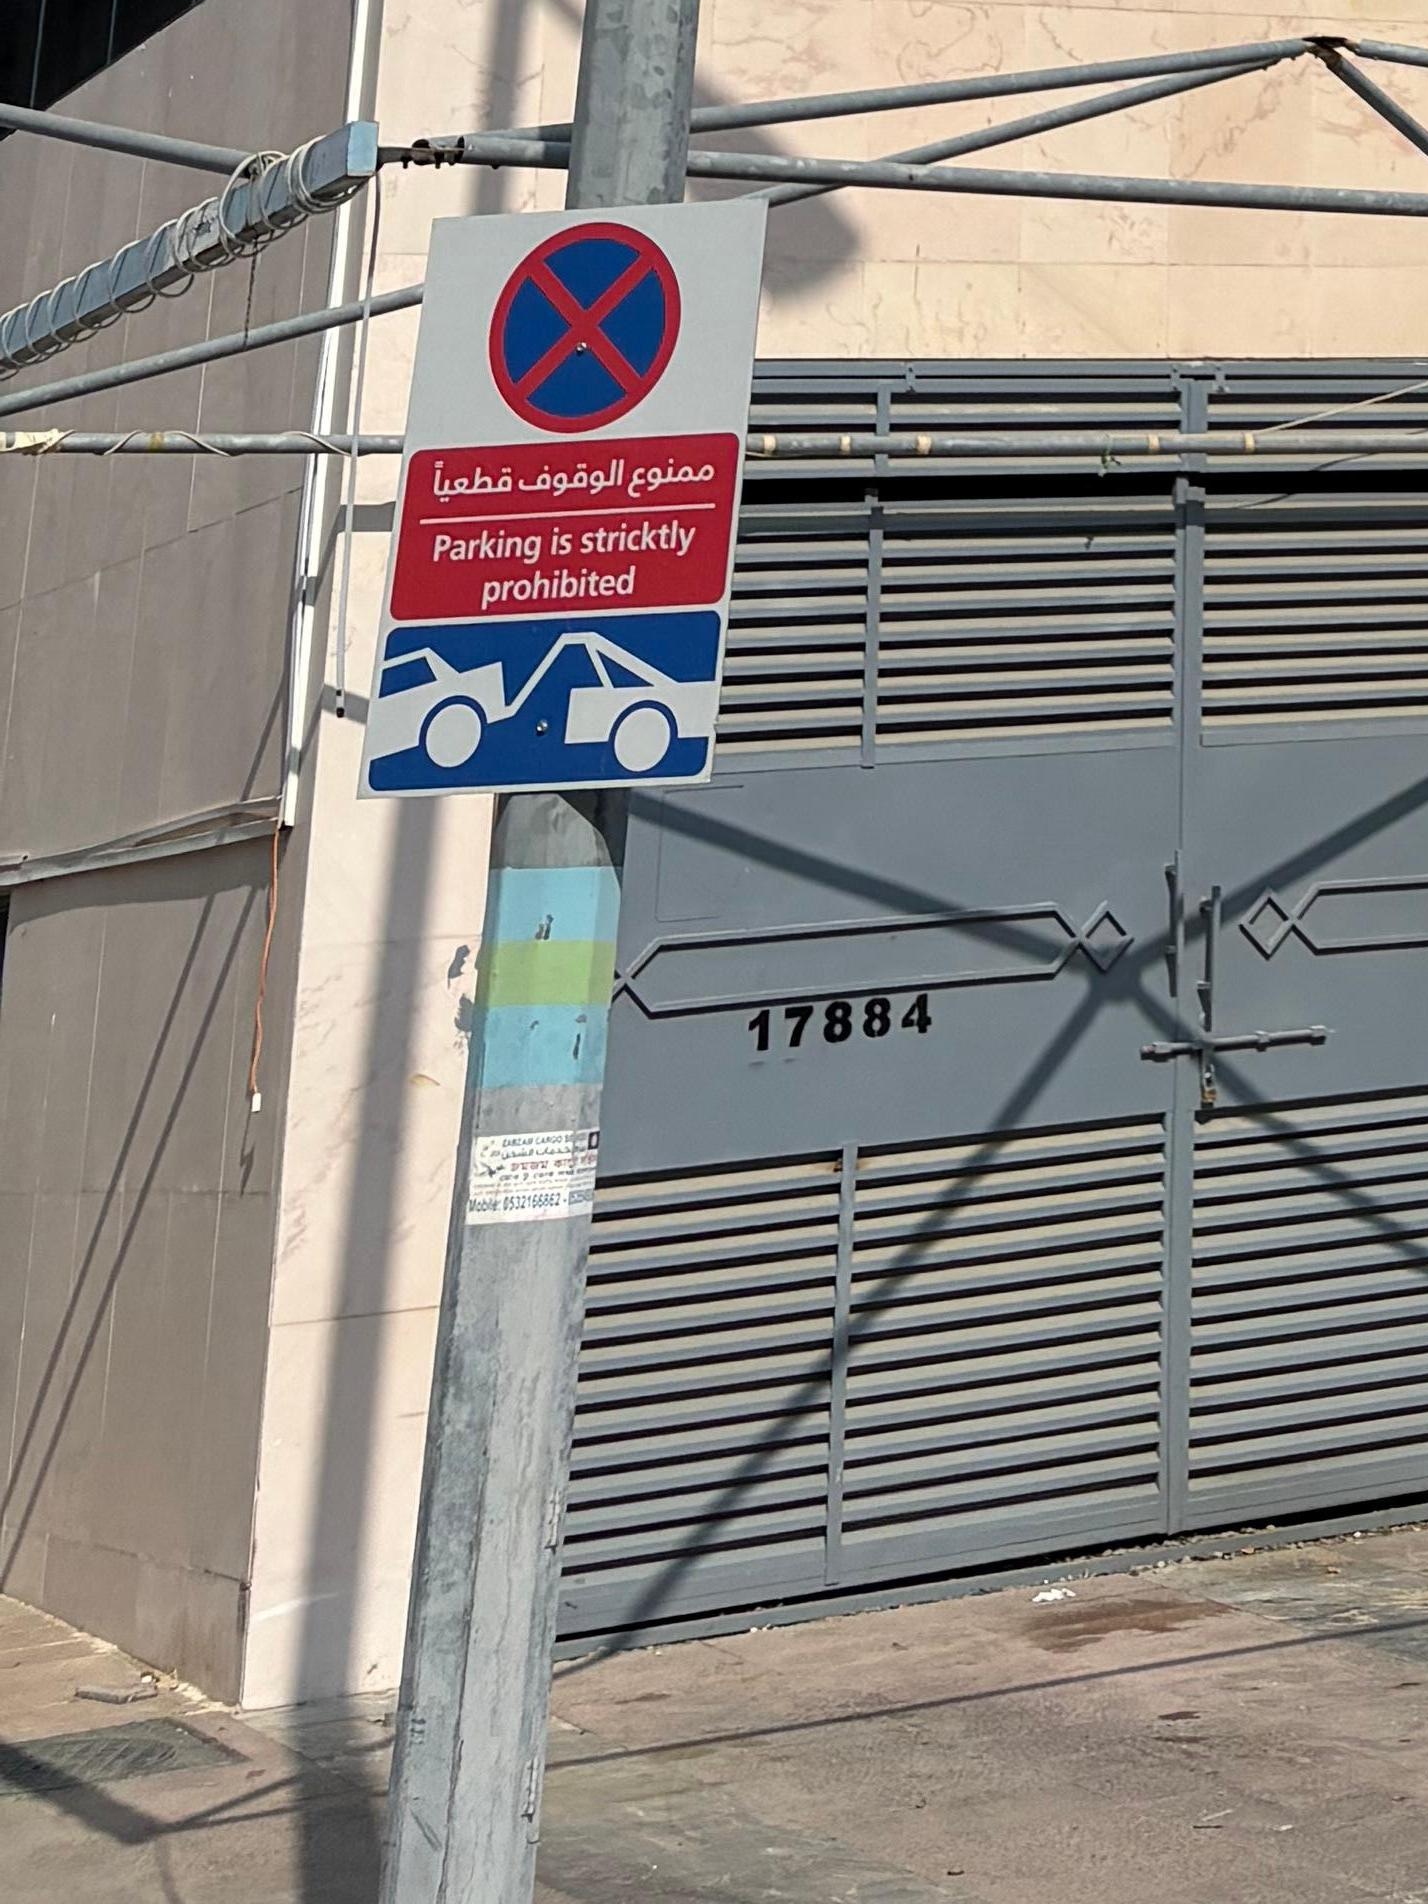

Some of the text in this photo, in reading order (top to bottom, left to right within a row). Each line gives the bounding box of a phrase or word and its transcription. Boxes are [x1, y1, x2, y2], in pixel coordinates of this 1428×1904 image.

[433, 458, 715, 503] ممنوع الوقوف قطعياً
[433, 520, 696, 565] Parking is stricktly
[481, 565, 636, 610] prohibited
[747, 993, 933, 1052] 17884
